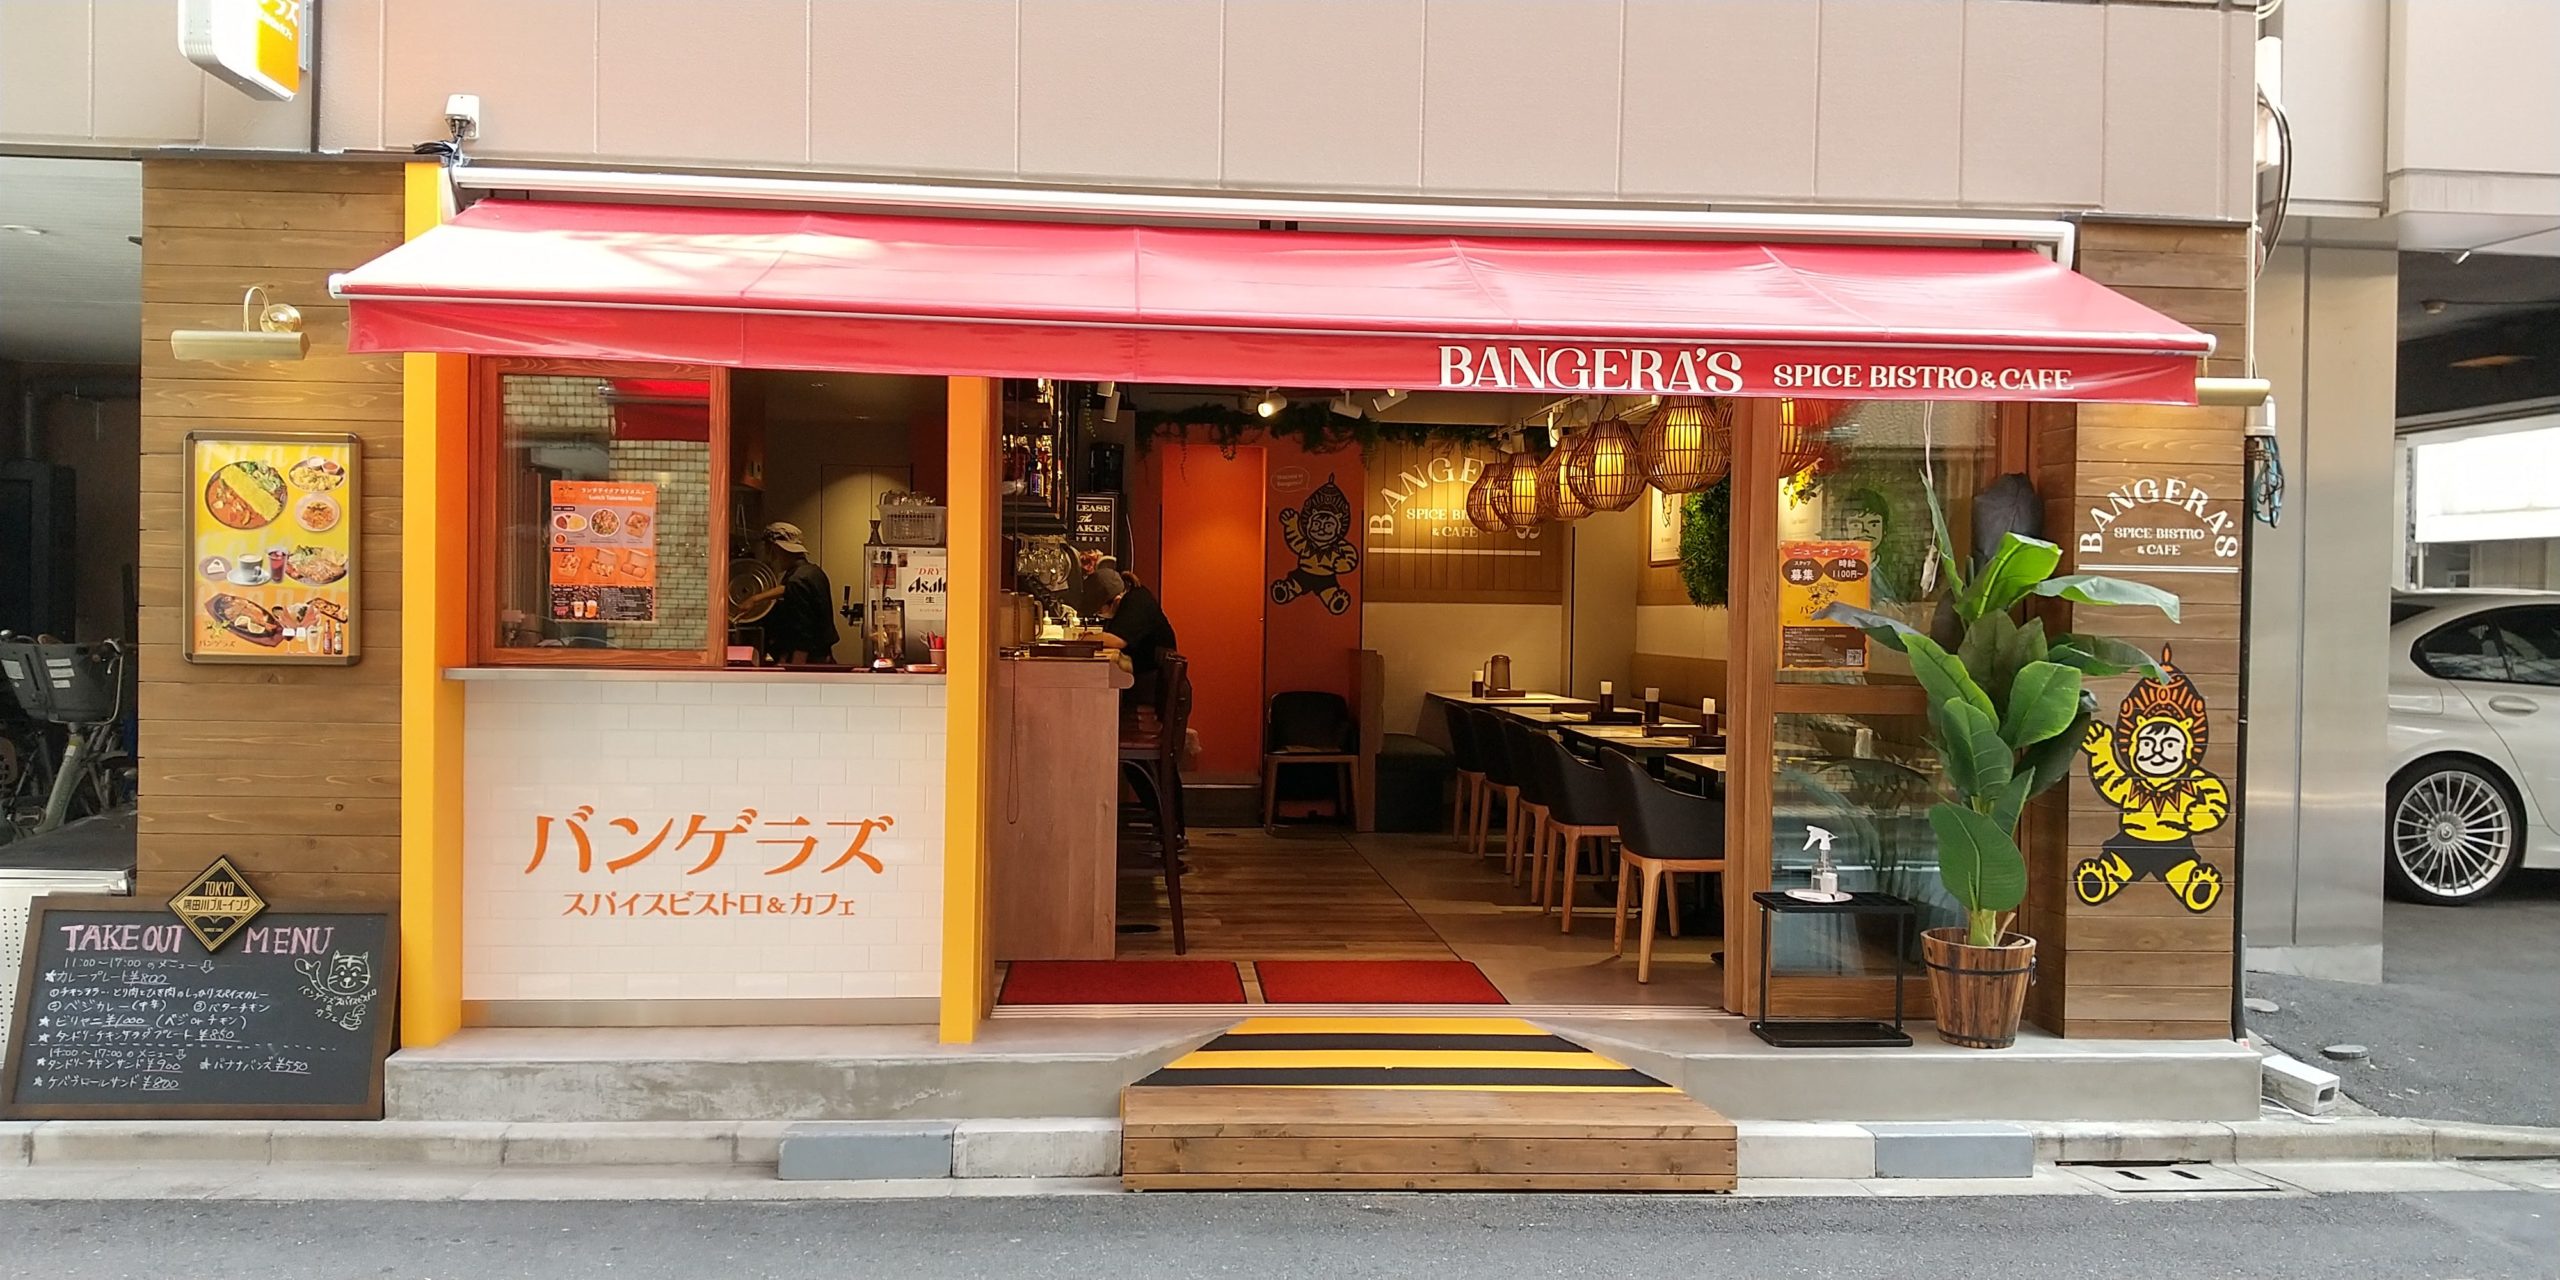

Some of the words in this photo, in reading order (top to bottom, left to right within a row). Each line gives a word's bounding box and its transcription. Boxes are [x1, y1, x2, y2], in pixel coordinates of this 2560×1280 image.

[1438, 345, 1744, 393] BANGERA'S
[1773, 364, 1863, 388] SPICE
[1076, 504, 1111, 513] LEASE
[1406, 508, 1447, 520] SPICE
[2079, 477, 2239, 558] BANGERA'S
[1076, 524, 1110, 533] AKEN
[2113, 527, 2153, 539] SPICE
[2156, 527, 2205, 540] BISTRO
[1793, 547, 1859, 556] ニューオープン
[1838, 559, 1857, 568] 時給
[1790, 569, 1814, 581] 募集
[907, 576, 946, 593] Asah
[523, 805, 895, 876] バンゲラズ
[205, 881, 235, 896] TOKYO
[183, 898, 251, 911] 隅田川ブルーイング
[561, 890, 856, 917] スパイスビストロ&カフェ
[241, 927, 335, 954] MENU
